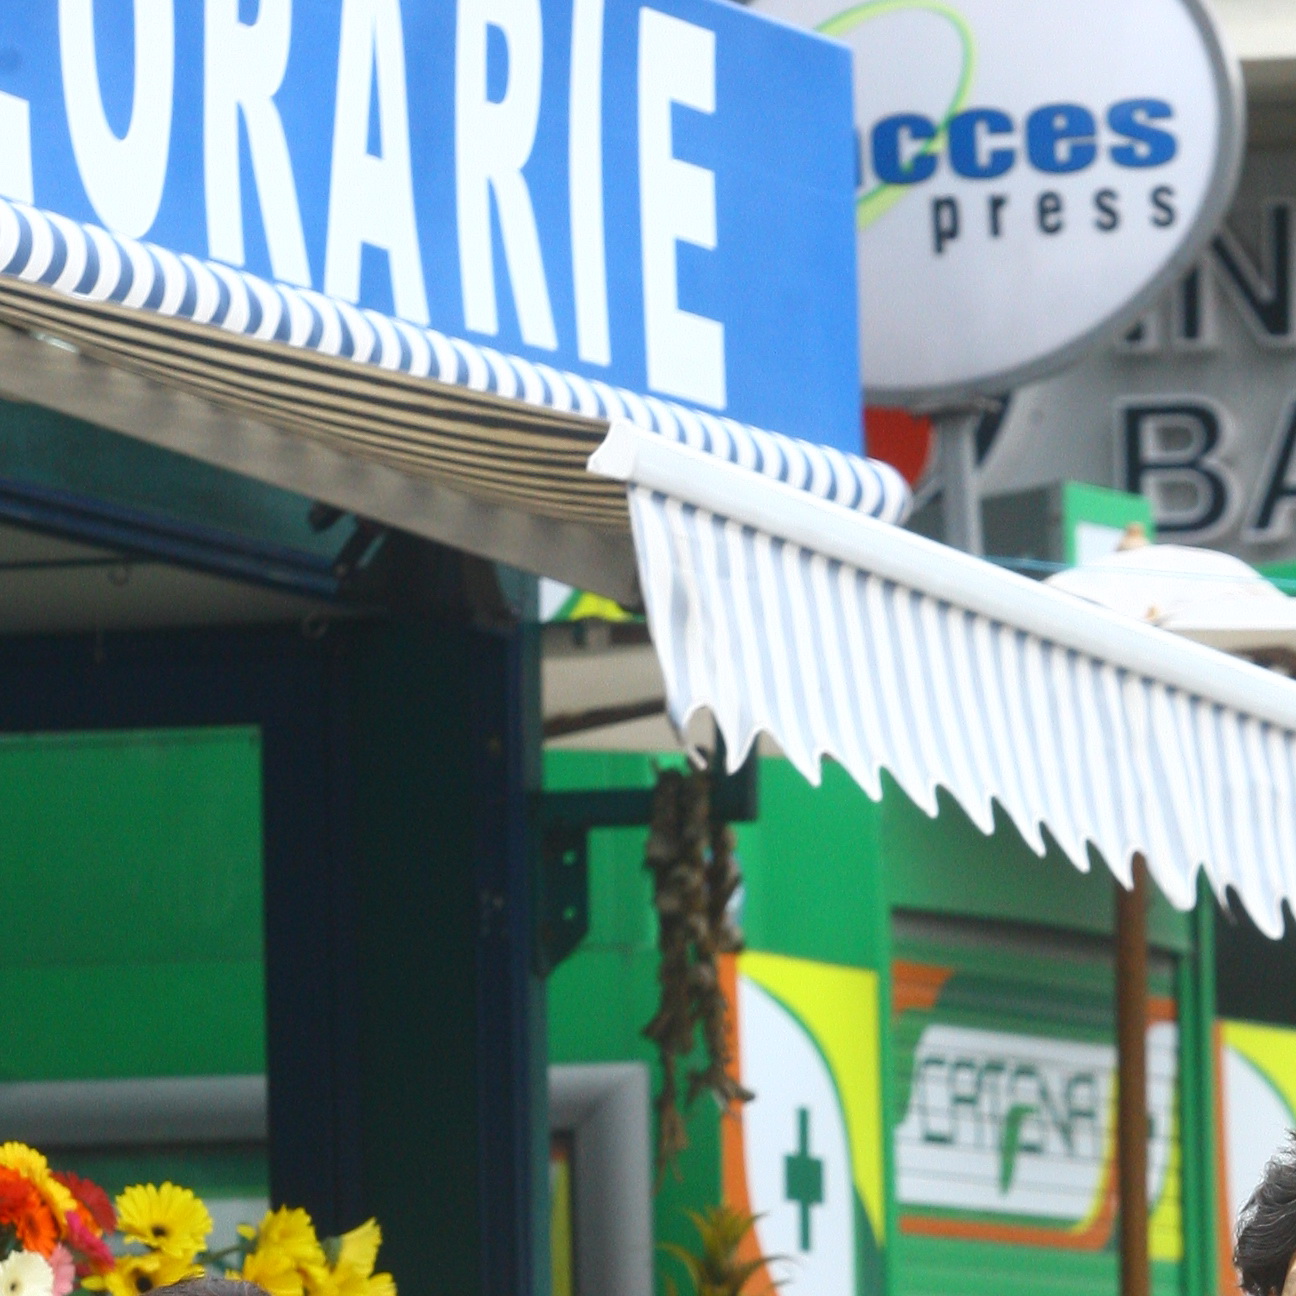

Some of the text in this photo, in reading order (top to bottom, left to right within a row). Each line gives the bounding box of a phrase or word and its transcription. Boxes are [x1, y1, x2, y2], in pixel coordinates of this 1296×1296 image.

[855, 97, 1178, 186] cces
[0, 0, 727, 410] ORARIE
[931, 185, 1177, 255] press
